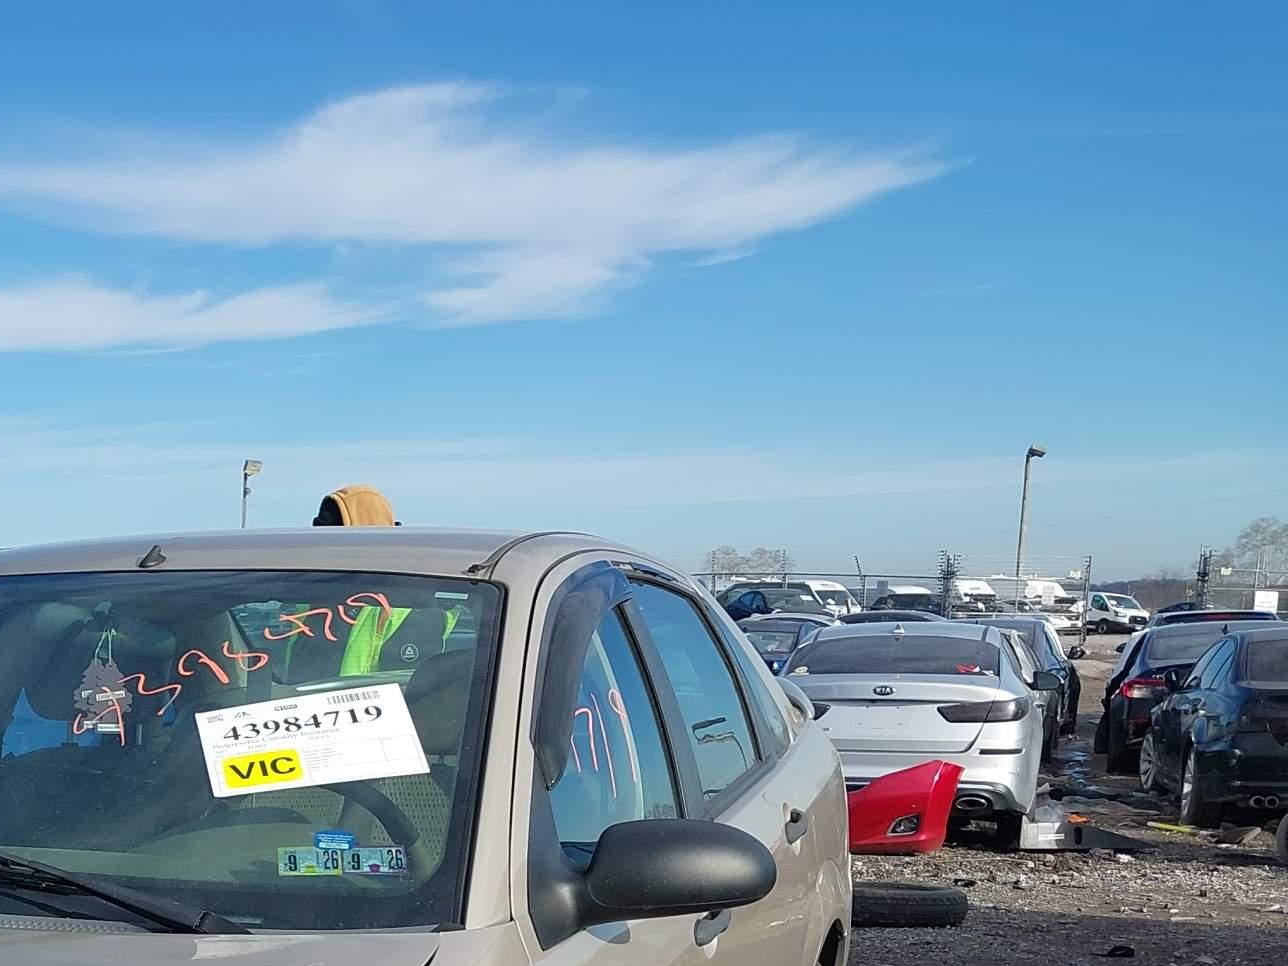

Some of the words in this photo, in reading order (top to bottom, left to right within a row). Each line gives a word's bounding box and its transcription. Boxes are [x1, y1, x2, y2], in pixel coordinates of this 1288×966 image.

[223, 705, 383, 740] 43984719
[229, 756, 297, 780] VIC
[288, 854, 298, 872] 9
[323, 850, 339, 870] 26
[351, 853, 361, 871] 9
[387, 849, 404, 870] 26
